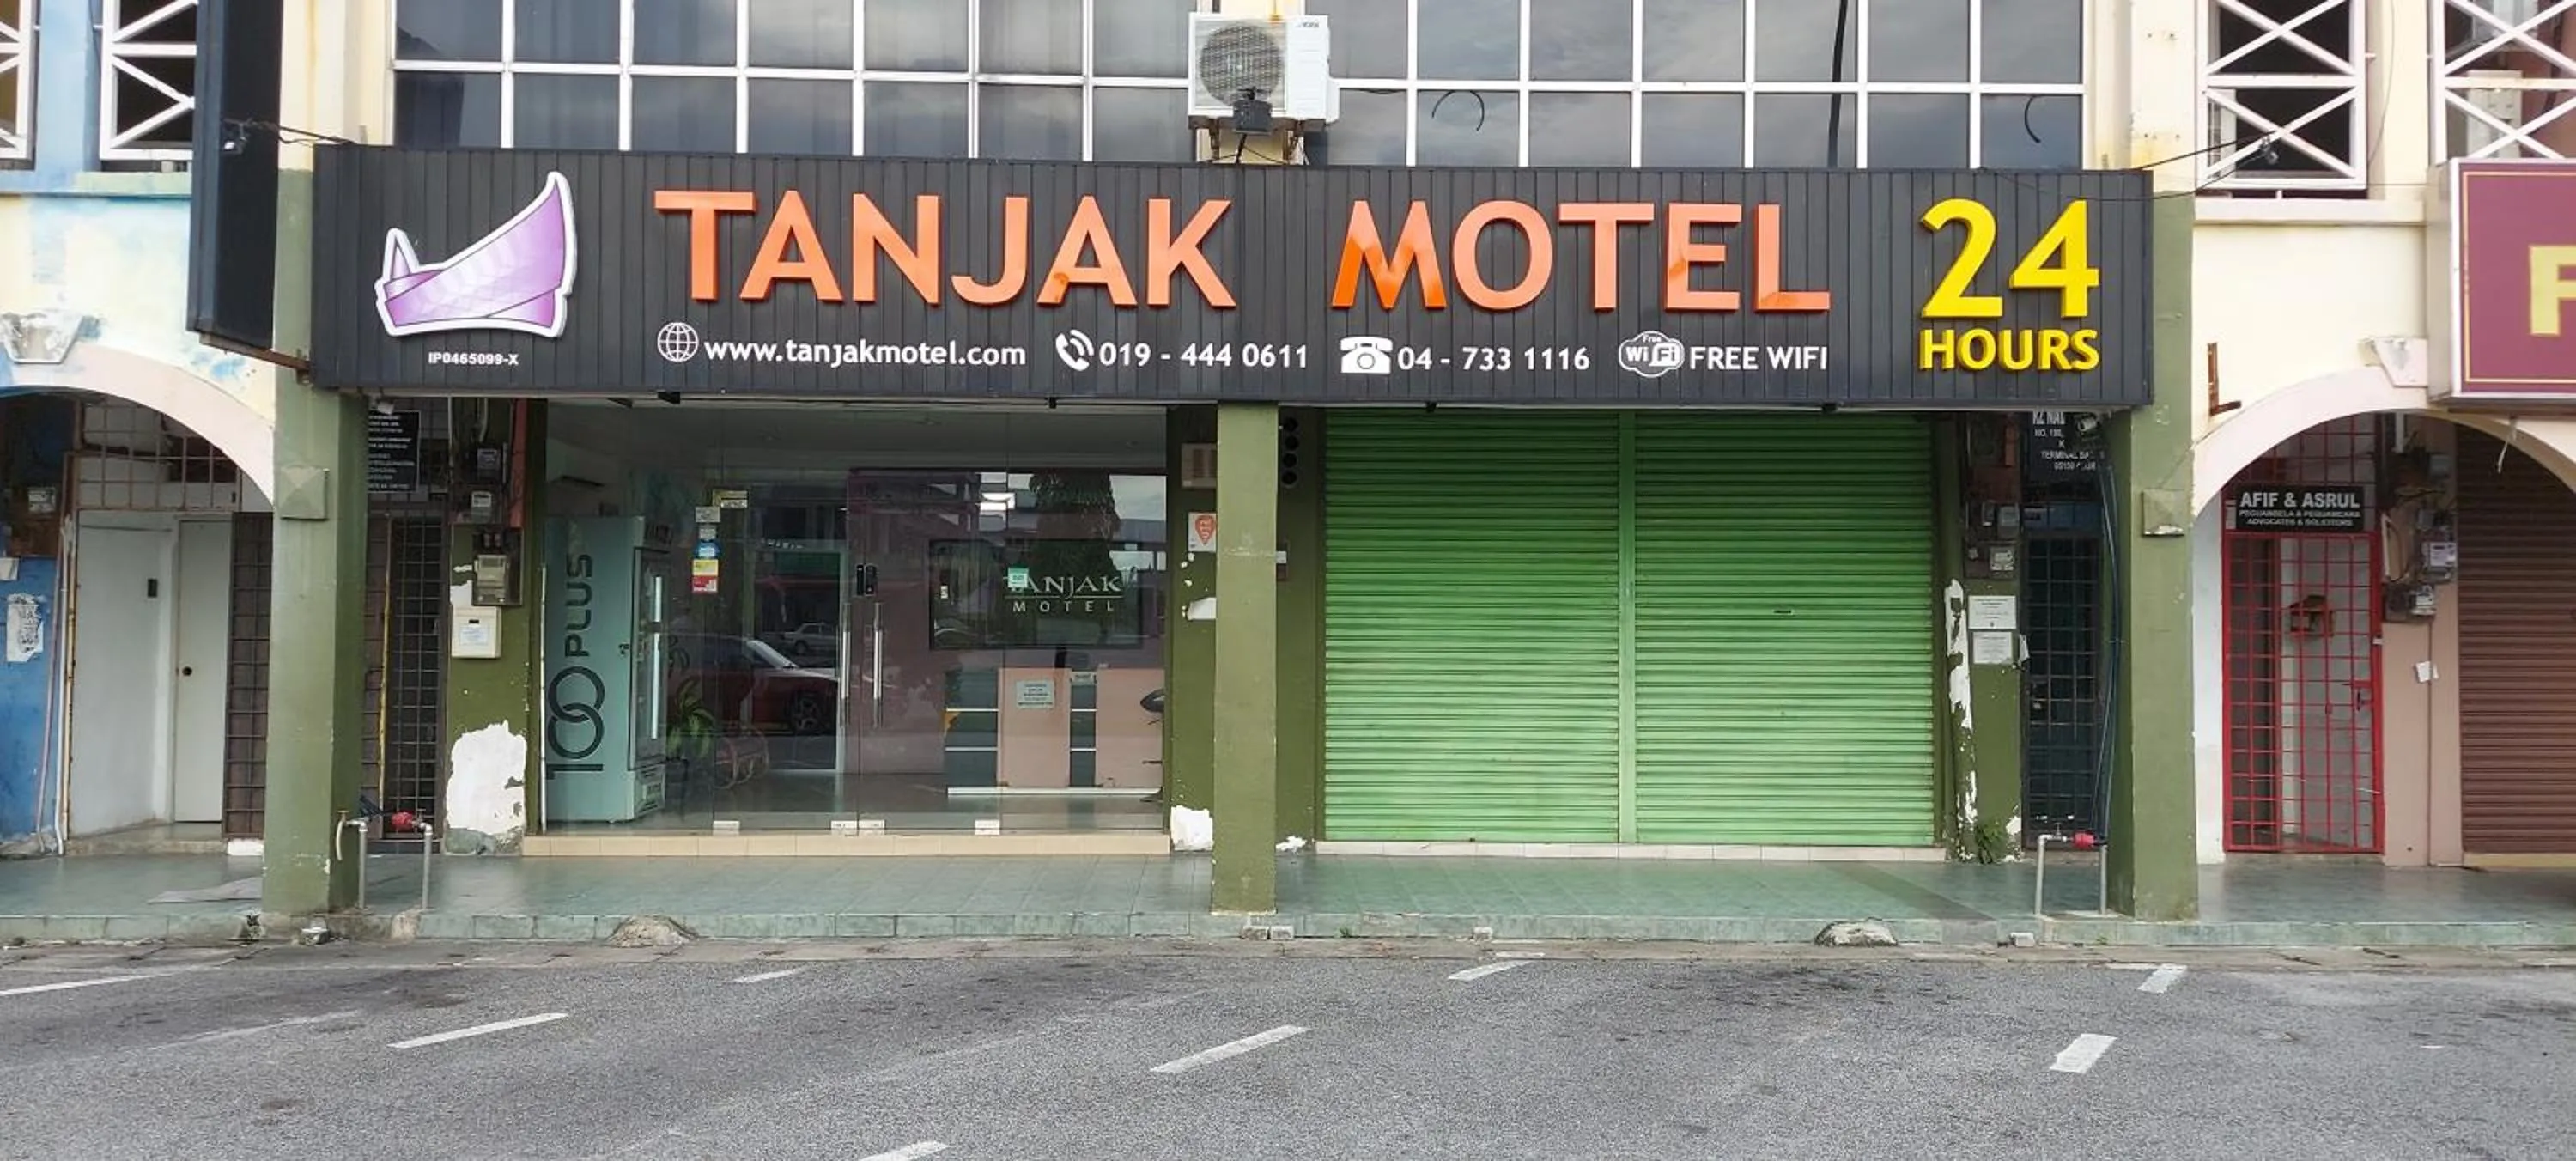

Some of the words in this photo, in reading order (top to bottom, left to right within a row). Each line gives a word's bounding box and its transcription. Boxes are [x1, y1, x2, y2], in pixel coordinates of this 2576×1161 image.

[653, 190, 1236, 307] TANJAK
[1331, 200, 1832, 311] MOTEL
[1920, 198, 2099, 318] 24
[428, 352, 519, 365] IP0465099-X
[704, 338, 1026, 368] www.tanjakmotel.com
[1099, 343, 1151, 367] 019
[1181, 343, 1232, 367] 444
[1242, 343, 1306, 368] 0611
[1397, 346, 1433, 370] 04
[1463, 346, 1511, 371] 733
[1524, 346, 1590, 370] 1116
[1689, 346, 1759, 370] FREE
[1766, 346, 1827, 370] WIFI
[1920, 328, 2100, 371] HOURS
[2239, 492, 2279, 508] AFIF
[2283, 492, 2297, 508] &
[2301, 492, 2360, 508] ASRUL
[1003, 575, 1121, 600] ANJAK
[1012, 601, 1115, 613] MOTEL
